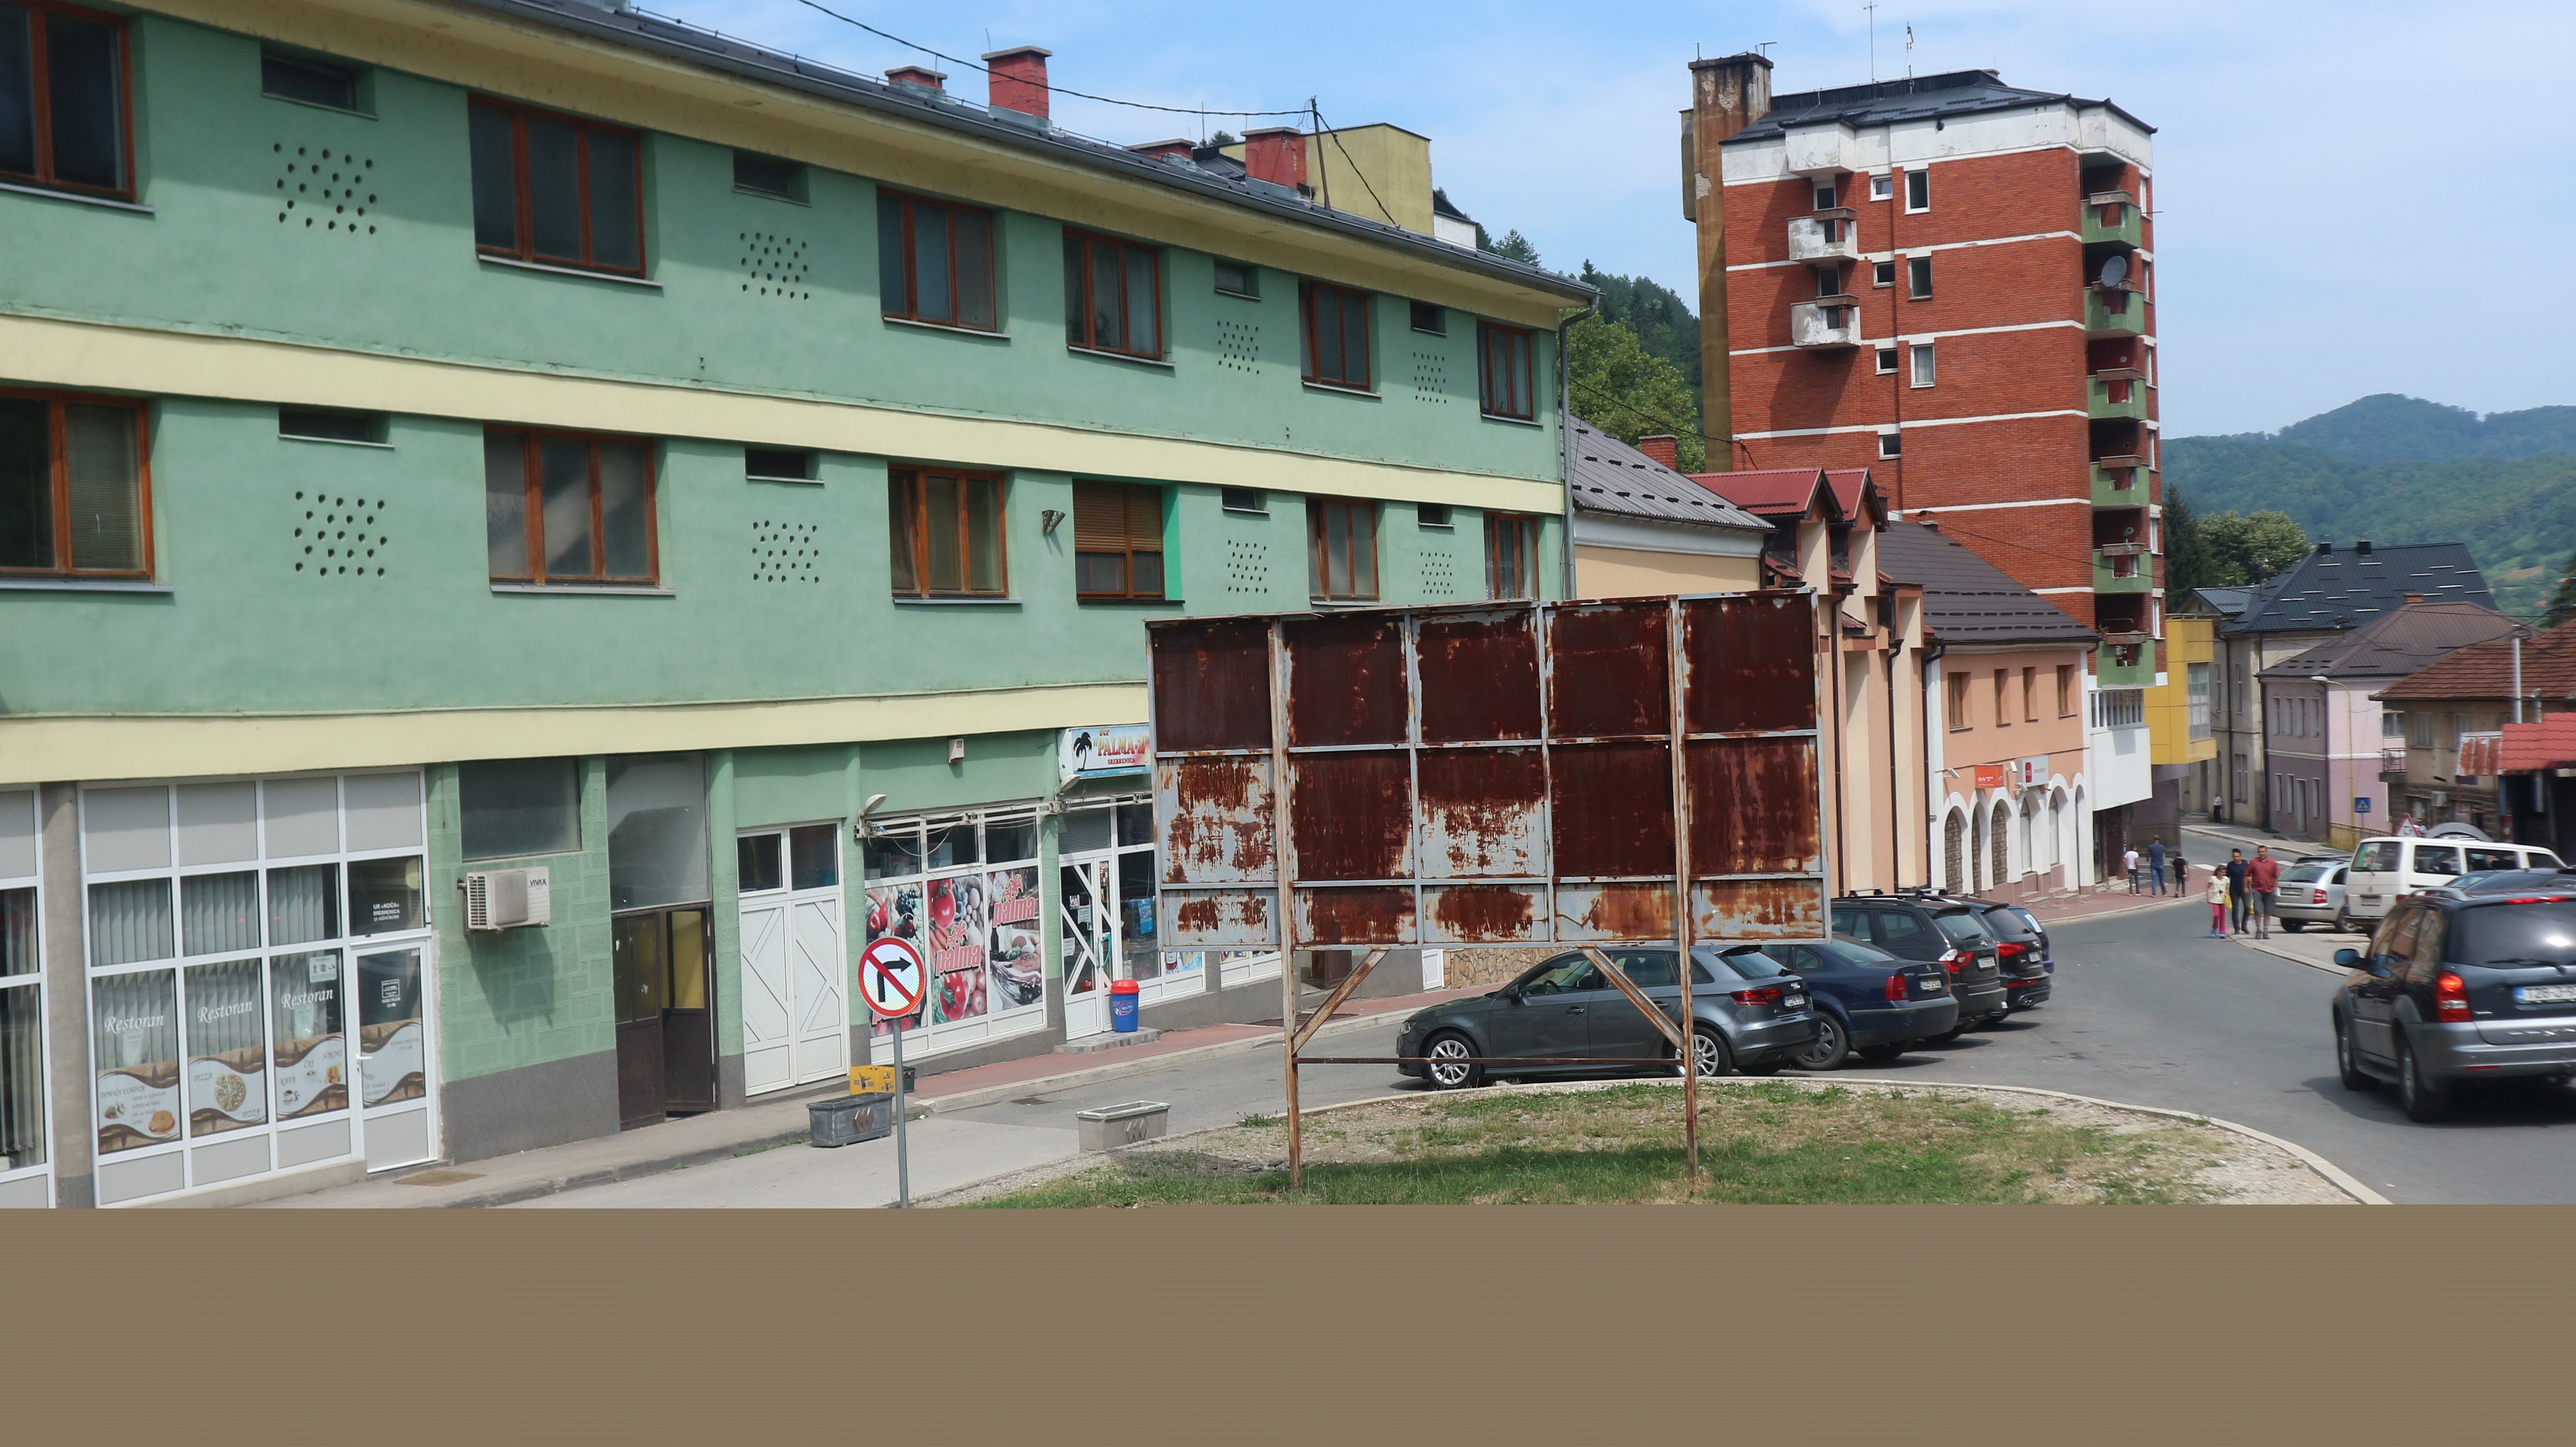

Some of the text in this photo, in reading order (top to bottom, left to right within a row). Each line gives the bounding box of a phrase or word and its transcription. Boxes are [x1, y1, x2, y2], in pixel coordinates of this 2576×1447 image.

[993, 896, 1036, 928] palma
[935, 943, 981, 976] palma
[281, 989, 333, 1009] Restoran
[197, 1001, 253, 1024] Restoran
[105, 1015, 164, 1034] Restoran
